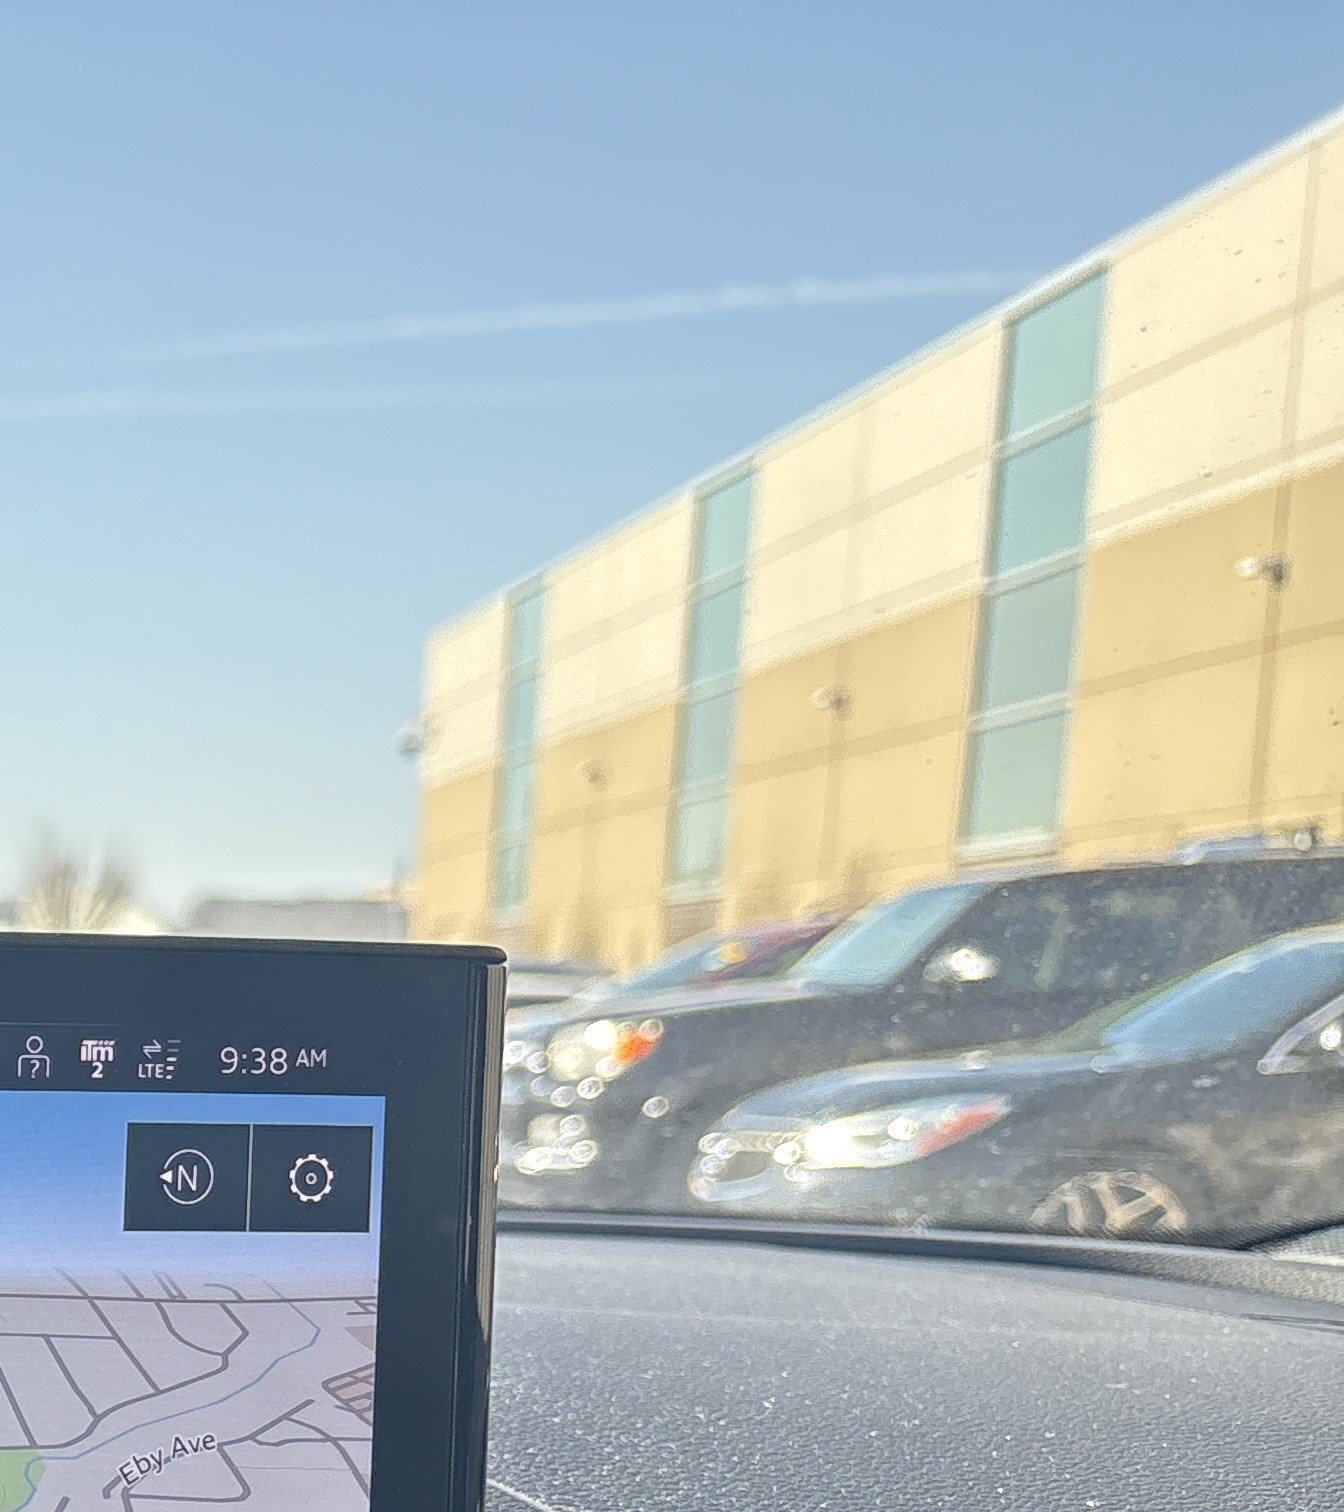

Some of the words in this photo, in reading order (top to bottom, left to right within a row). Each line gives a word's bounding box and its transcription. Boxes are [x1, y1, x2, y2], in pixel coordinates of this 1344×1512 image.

[138, 1063, 164, 1078] LTE
[219, 1046, 288, 1075] 9:38
[295, 1048, 327, 1068] AM
[119, 1449, 163, 1485] Eby
[171, 1434, 216, 1459] Ave
